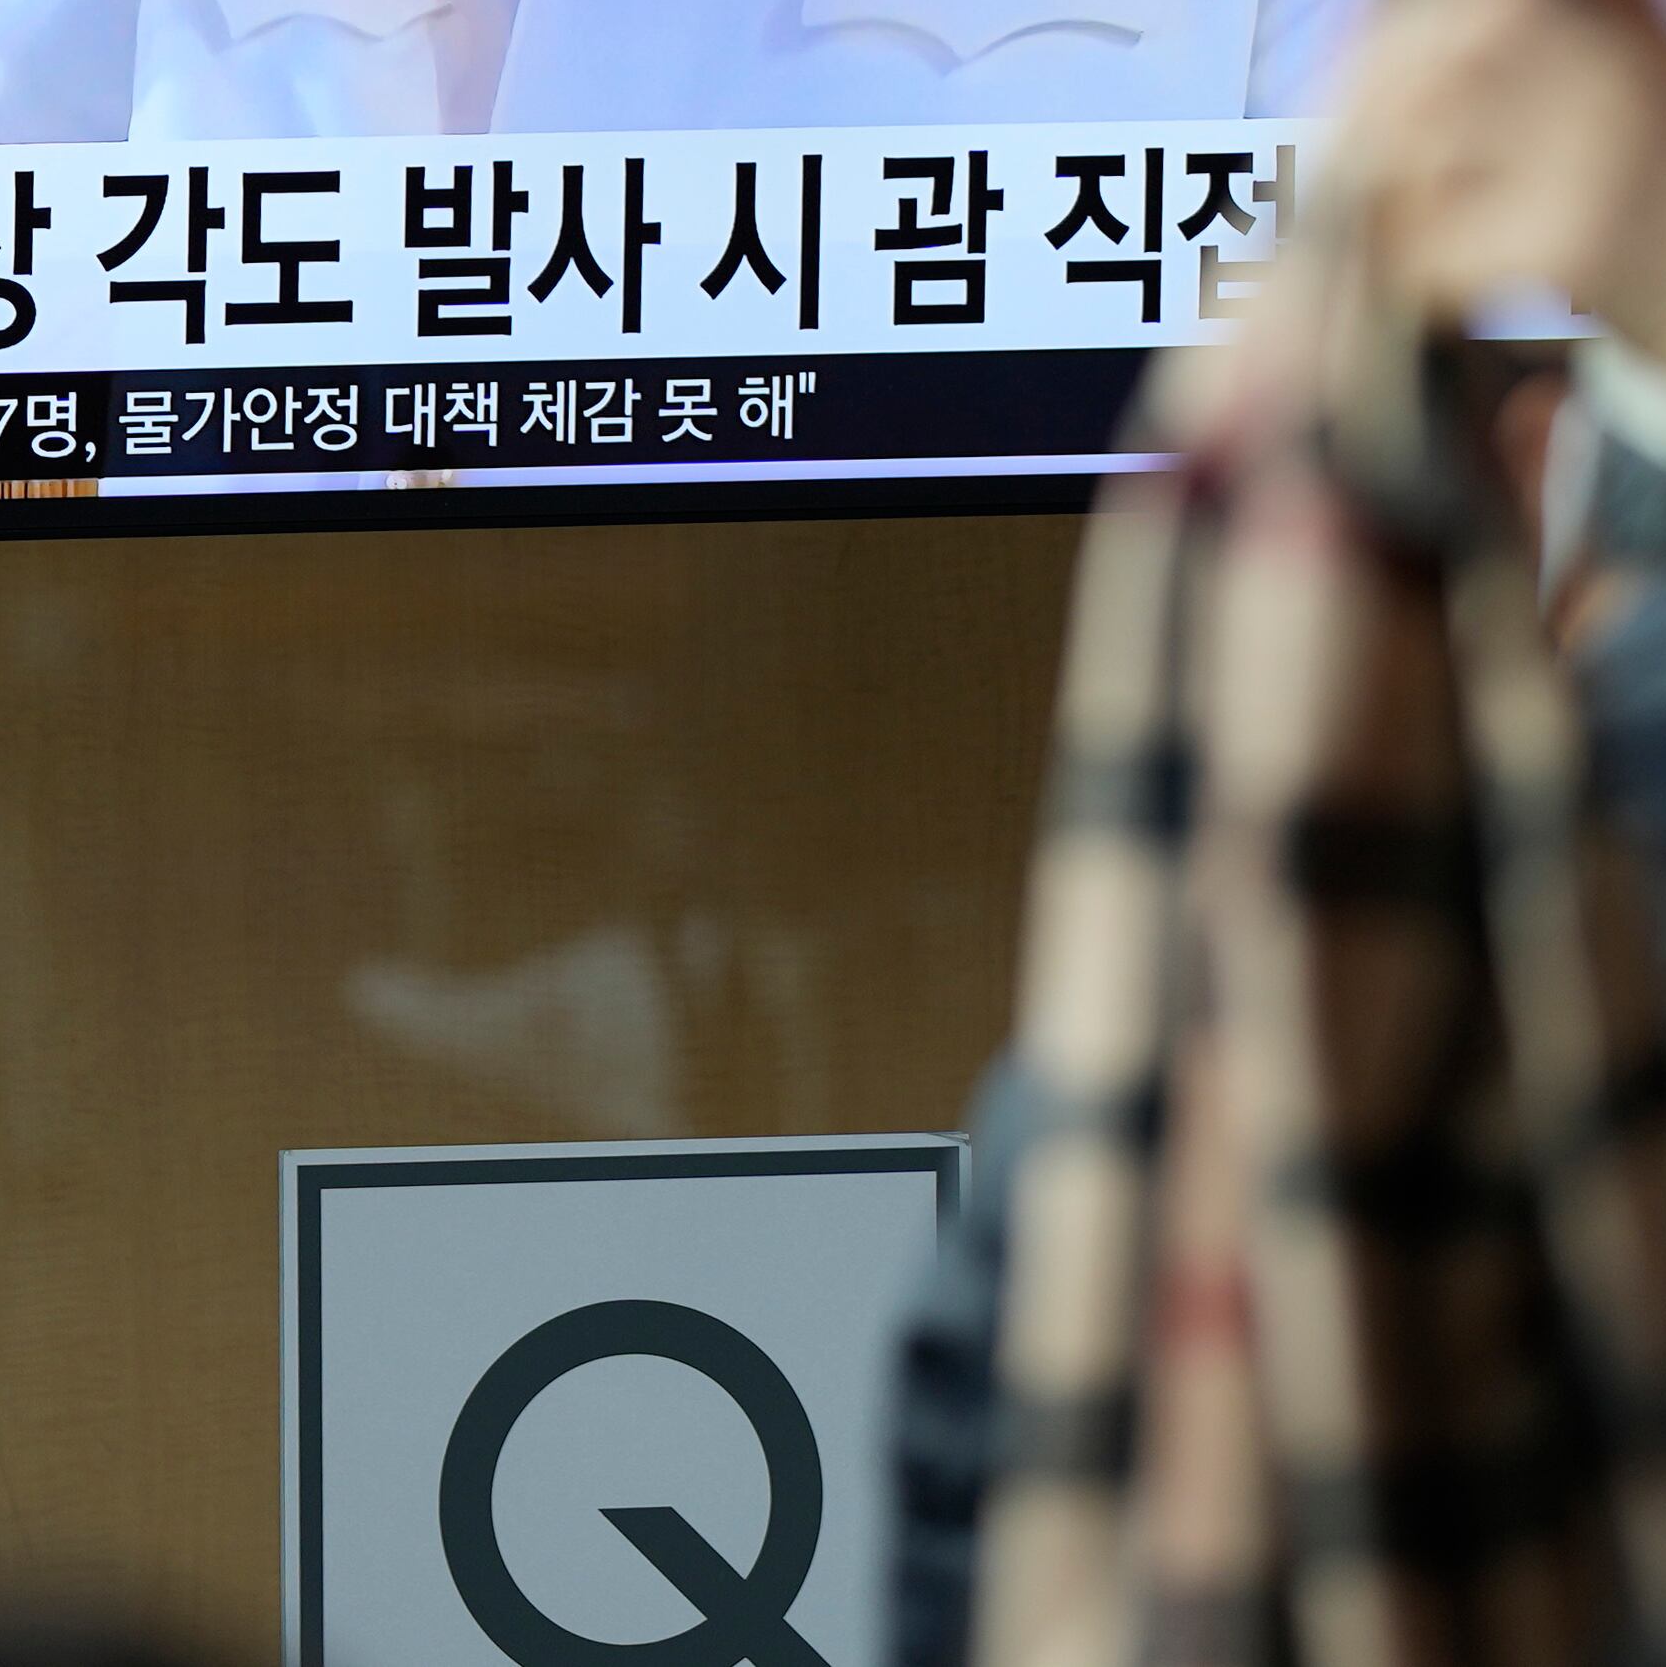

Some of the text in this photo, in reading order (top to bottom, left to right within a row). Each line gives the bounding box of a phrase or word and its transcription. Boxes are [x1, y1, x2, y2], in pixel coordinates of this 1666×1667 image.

[95, 164, 355, 345] 각도
[403, 156, 662, 337] 발사
[699, 153, 822, 331] 시
[873, 149, 1005, 327] 괌
[118, 384, 360, 456] 물가안정
[384, 379, 501, 449] 대책
[520, 377, 642, 447] 체감
[657, 376, 720, 442] 못
[737, 371, 819, 441] 해"
[439, 1299, 833, 1667] Q
